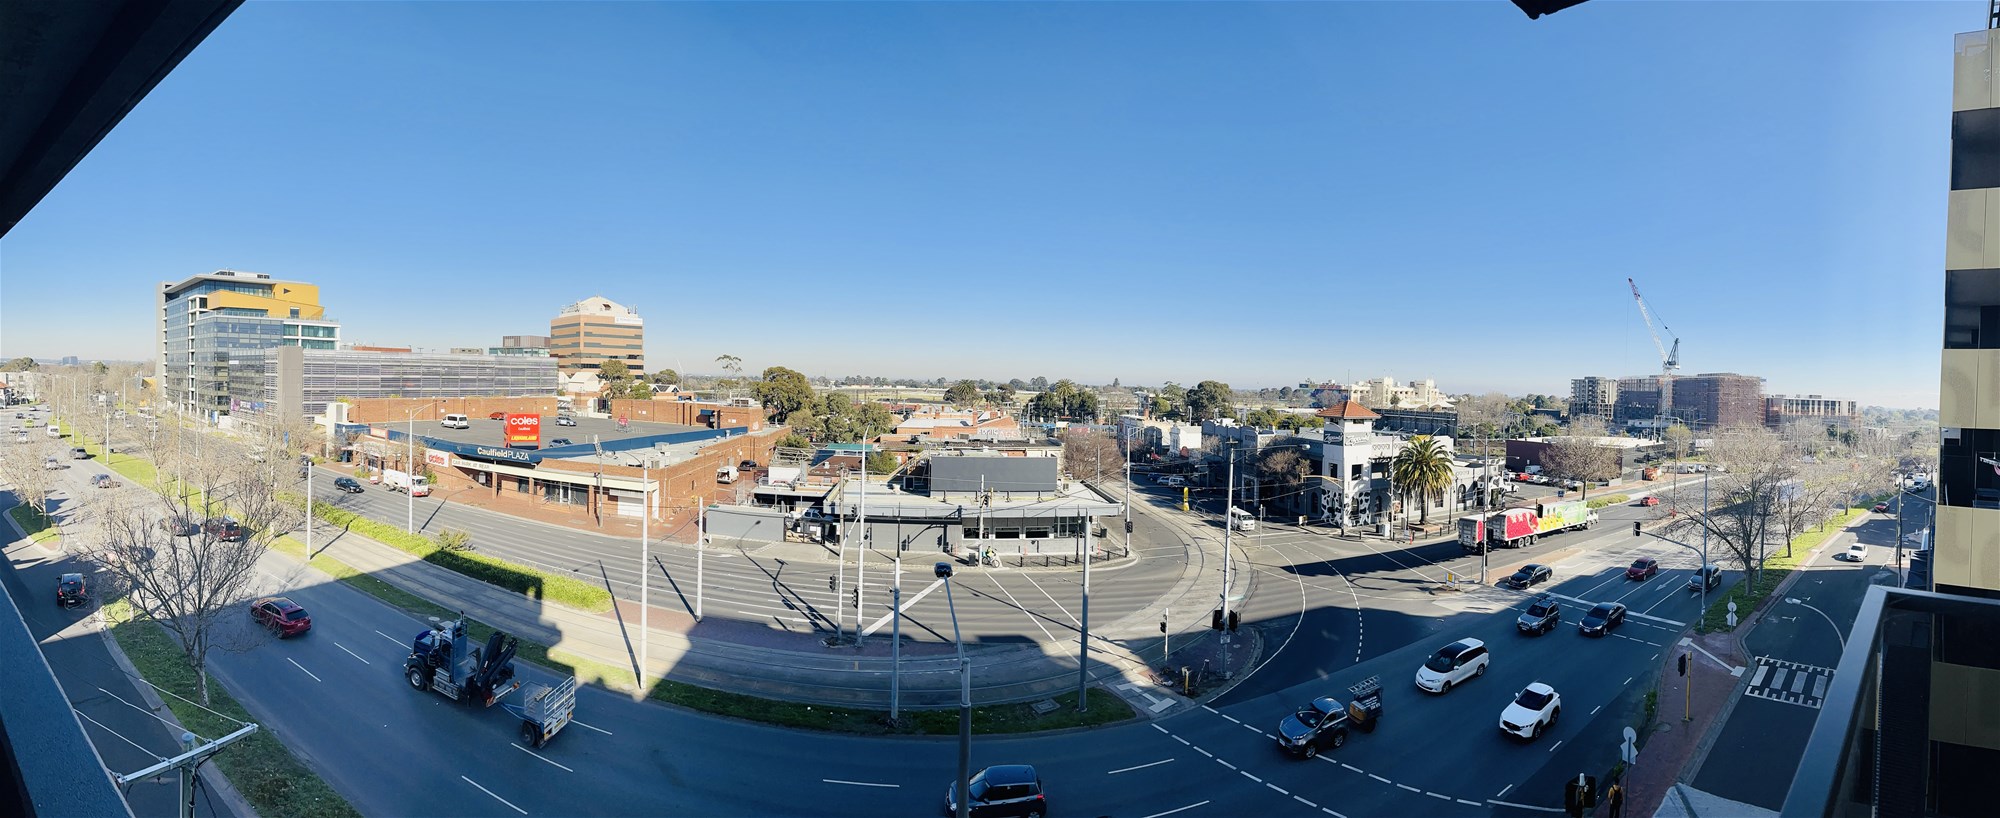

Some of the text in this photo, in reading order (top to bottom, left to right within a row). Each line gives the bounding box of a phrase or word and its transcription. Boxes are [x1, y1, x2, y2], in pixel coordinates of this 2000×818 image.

[510, 416, 538, 426] coles
[428, 454, 445, 465] coles
[477, 447, 530, 461] Caulfield PLAZA
